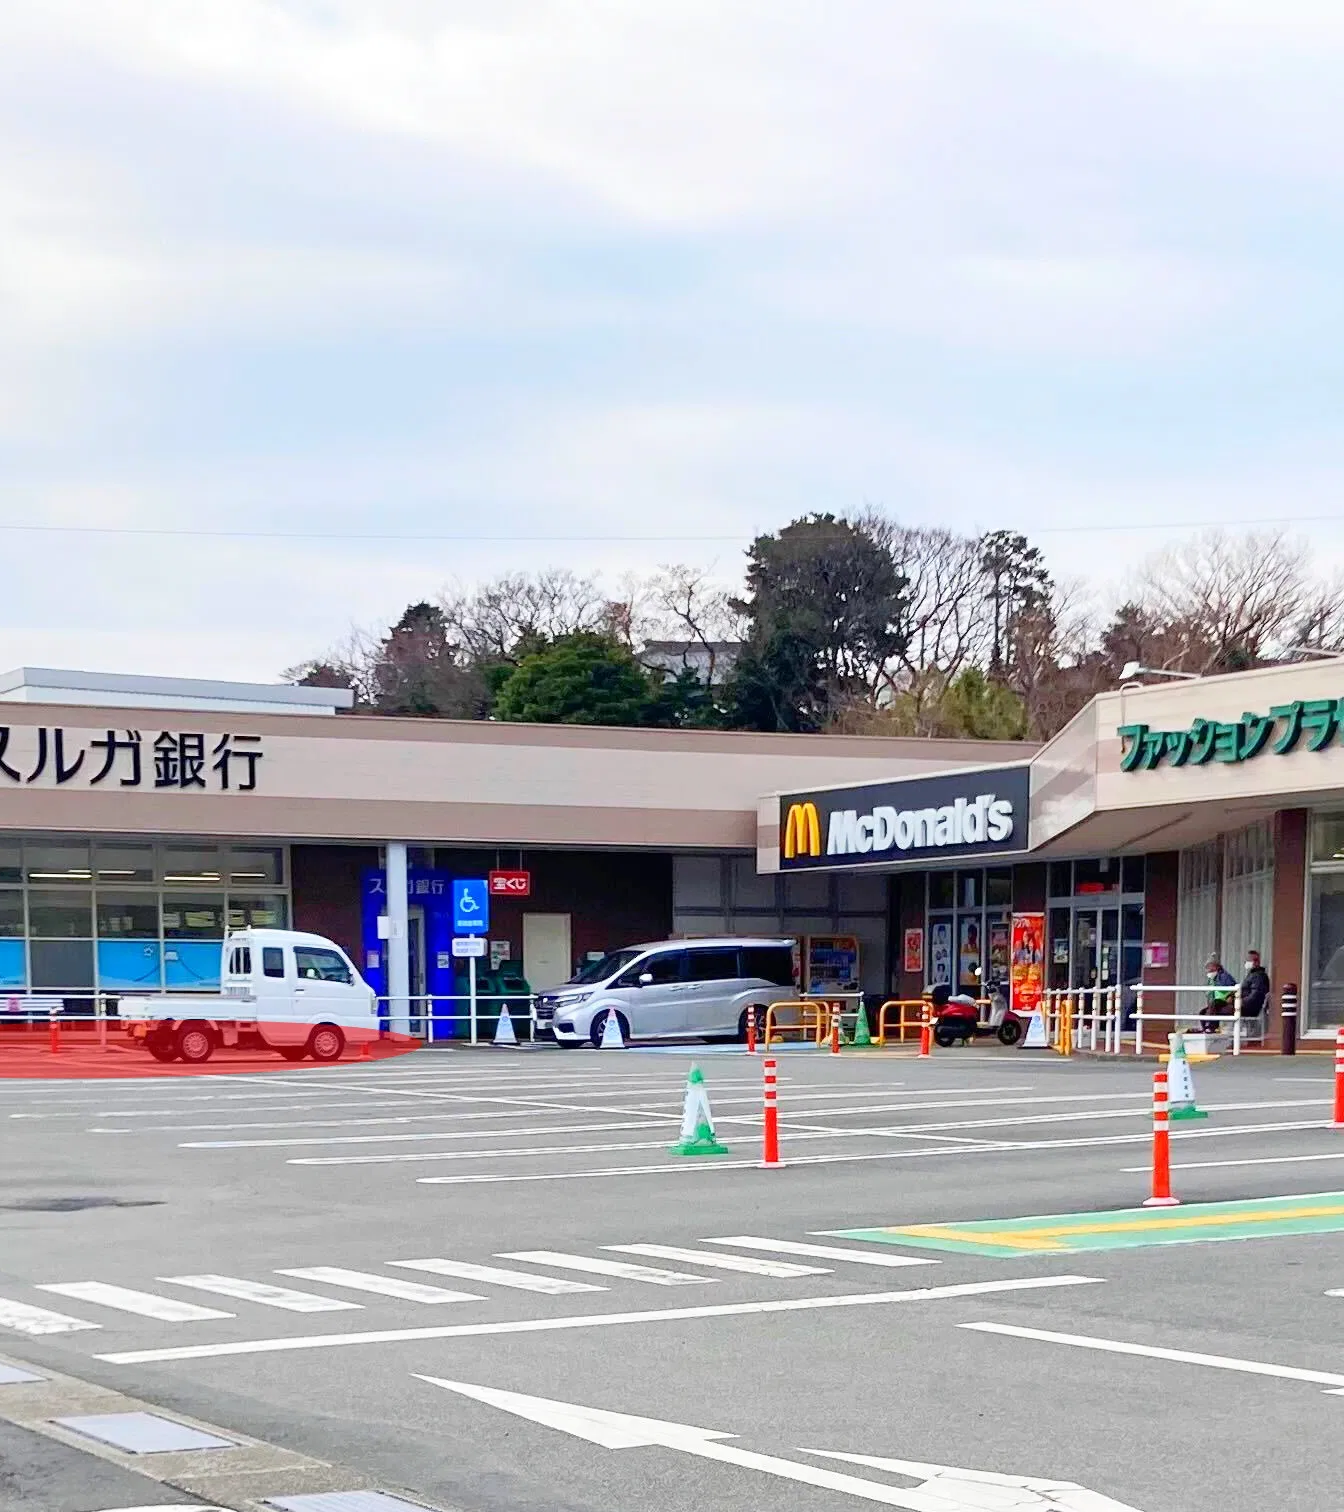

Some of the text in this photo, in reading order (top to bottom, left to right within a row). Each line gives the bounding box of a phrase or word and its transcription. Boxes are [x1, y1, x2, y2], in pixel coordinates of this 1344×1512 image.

[826, 794, 1013, 856] McDonald's
[368, 878, 445, 895] ス銀行
[493, 877, 526, 890] 宝くじ
